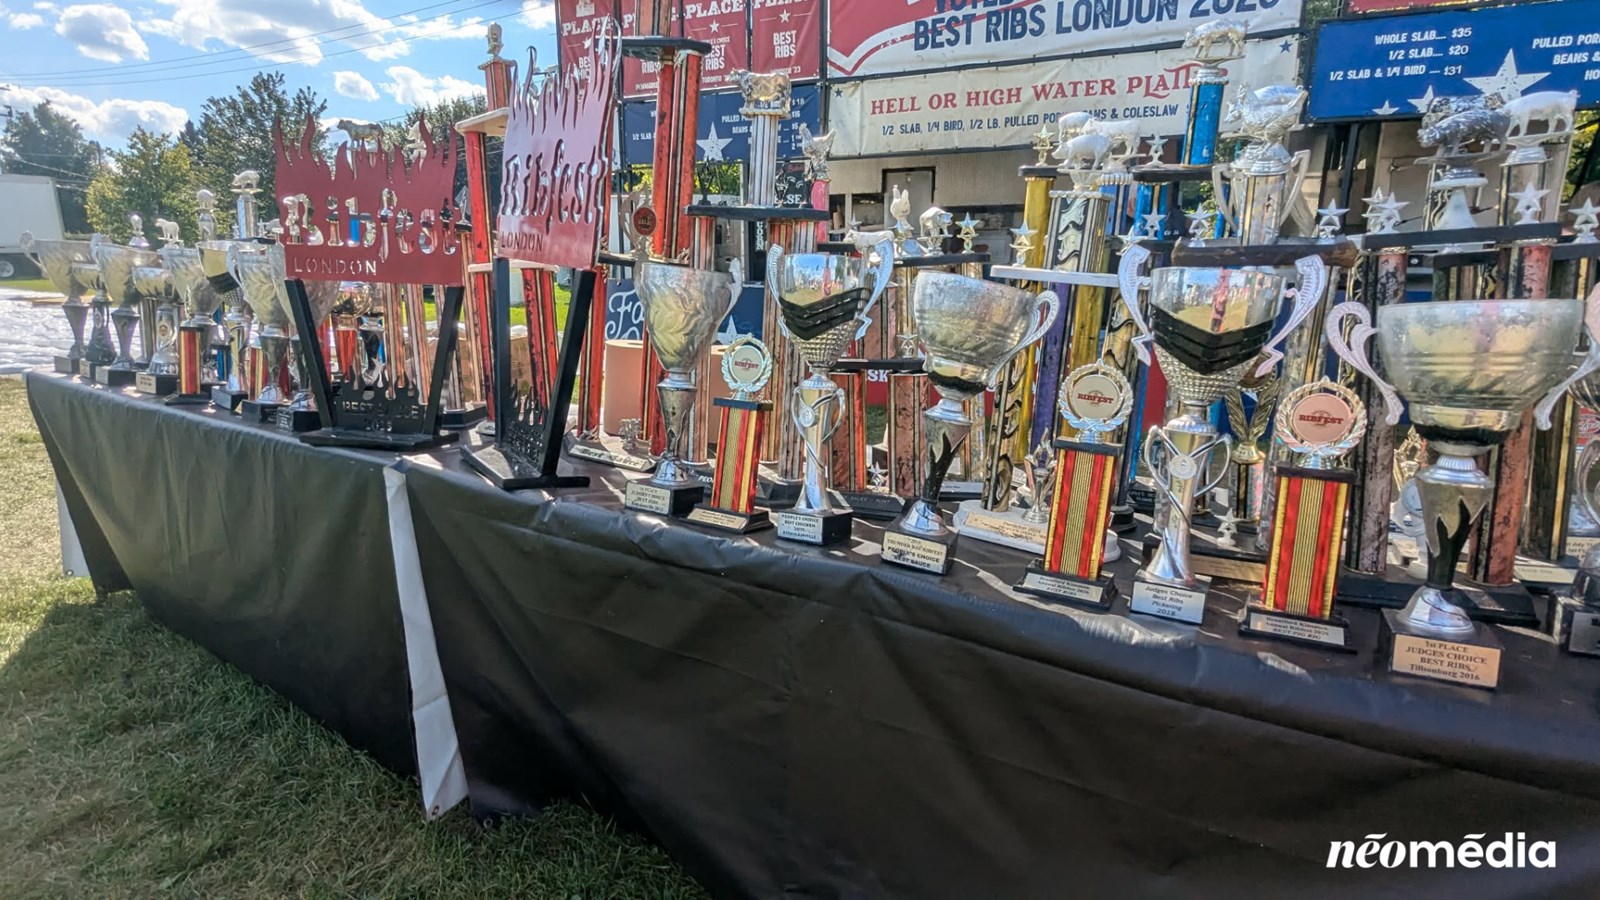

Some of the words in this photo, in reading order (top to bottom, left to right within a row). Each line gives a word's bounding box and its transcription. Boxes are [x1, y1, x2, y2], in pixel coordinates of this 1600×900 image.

[914, 13, 976, 51] BEST
[985, 4, 1046, 43] RIBS
[1055, 0, 1177, 35] LONDON
[773, 31, 797, 46] BEST
[1375, 32, 1408, 45] WHOLE
[1451, 27, 1472, 38] $35
[1532, 35, 1573, 49] PULLED
[775, 45, 796, 59] RIBS
[1389, 49, 1404, 61] 1/2
[1449, 45, 1469, 56] $20
[1552, 52, 1589, 65] BEANS
[705, 58, 725, 71] RIBS
[1329, 70, 1343, 81] 1/2
[1347, 68, 1370, 79] SLAB
[1374, 68, 1383, 78] &
[1404, 65, 1426, 76] BIRD
[1444, 65, 1462, 76] $31
[870, 96, 921, 115] HELL
[928, 92, 958, 110] OR
[965, 87, 1022, 107] HIGH
[1031, 77, 1116, 101] WATER
[882, 125, 894, 135] 1/2
[900, 123, 922, 135] SLAB,
[927, 121, 939, 132] 1/4
[944, 119, 965, 131] BIRD,
[970, 119, 983, 130] 1/2
[987, 118, 1001, 129] LB.
[1004, 114, 1038, 128] PULLED
[1111, 107, 1119, 119] &
[1123, 104, 1179, 118] COLESLAW
[501, 230, 543, 250] LONDON
[294, 257, 377, 276] LONDON
[1077, 393, 1114, 404] RIBFEST
[1298, 414, 1344, 425] RIBFEST
[1145, 586, 1168, 595] Judges
[1170, 590, 1193, 598] Choice
[1152, 600, 1182, 611] Pickering
[1425, 640, 1436, 648] 1st
[1438, 643, 1469, 653] PLACE
[1406, 646, 1445, 657] JUDGES
[1446, 652, 1488, 665] CHOICE
[1420, 656, 1445, 667] BEST
[1446, 660, 1472, 671] RIBS
[1409, 663, 1458, 679] Tillsonburg
[1459, 671, 1480, 681] 2016
